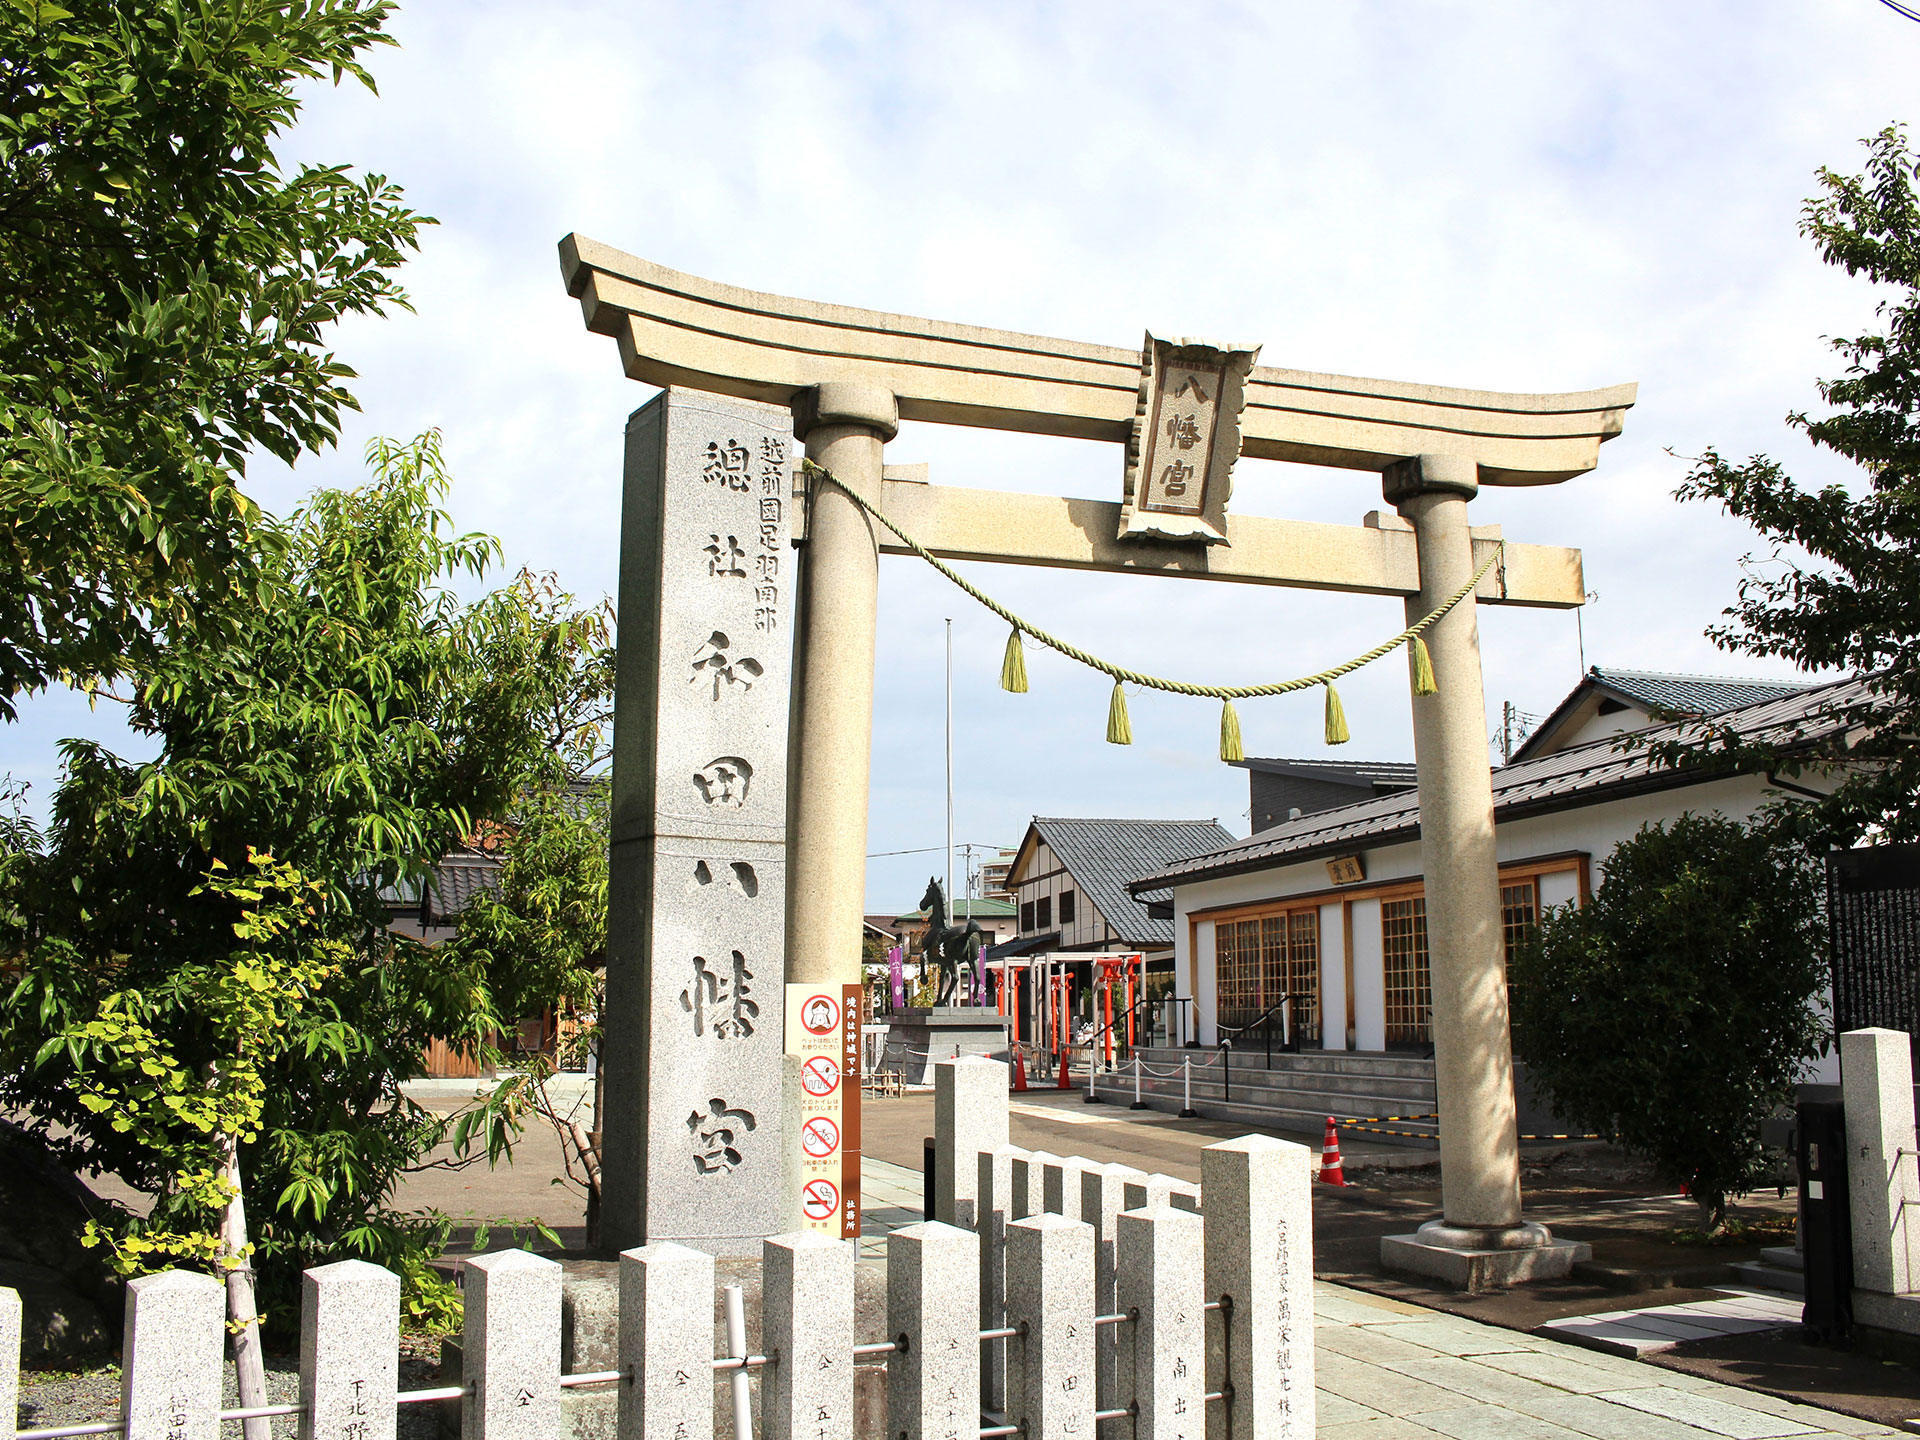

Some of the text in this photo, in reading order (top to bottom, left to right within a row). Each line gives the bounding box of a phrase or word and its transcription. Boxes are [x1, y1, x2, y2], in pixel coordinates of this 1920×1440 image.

[1159, 375, 1210, 498] 八幡宮
[754, 436, 786, 634] 越前國足羽南郡
[845, 1199, 856, 1231] 社務所
